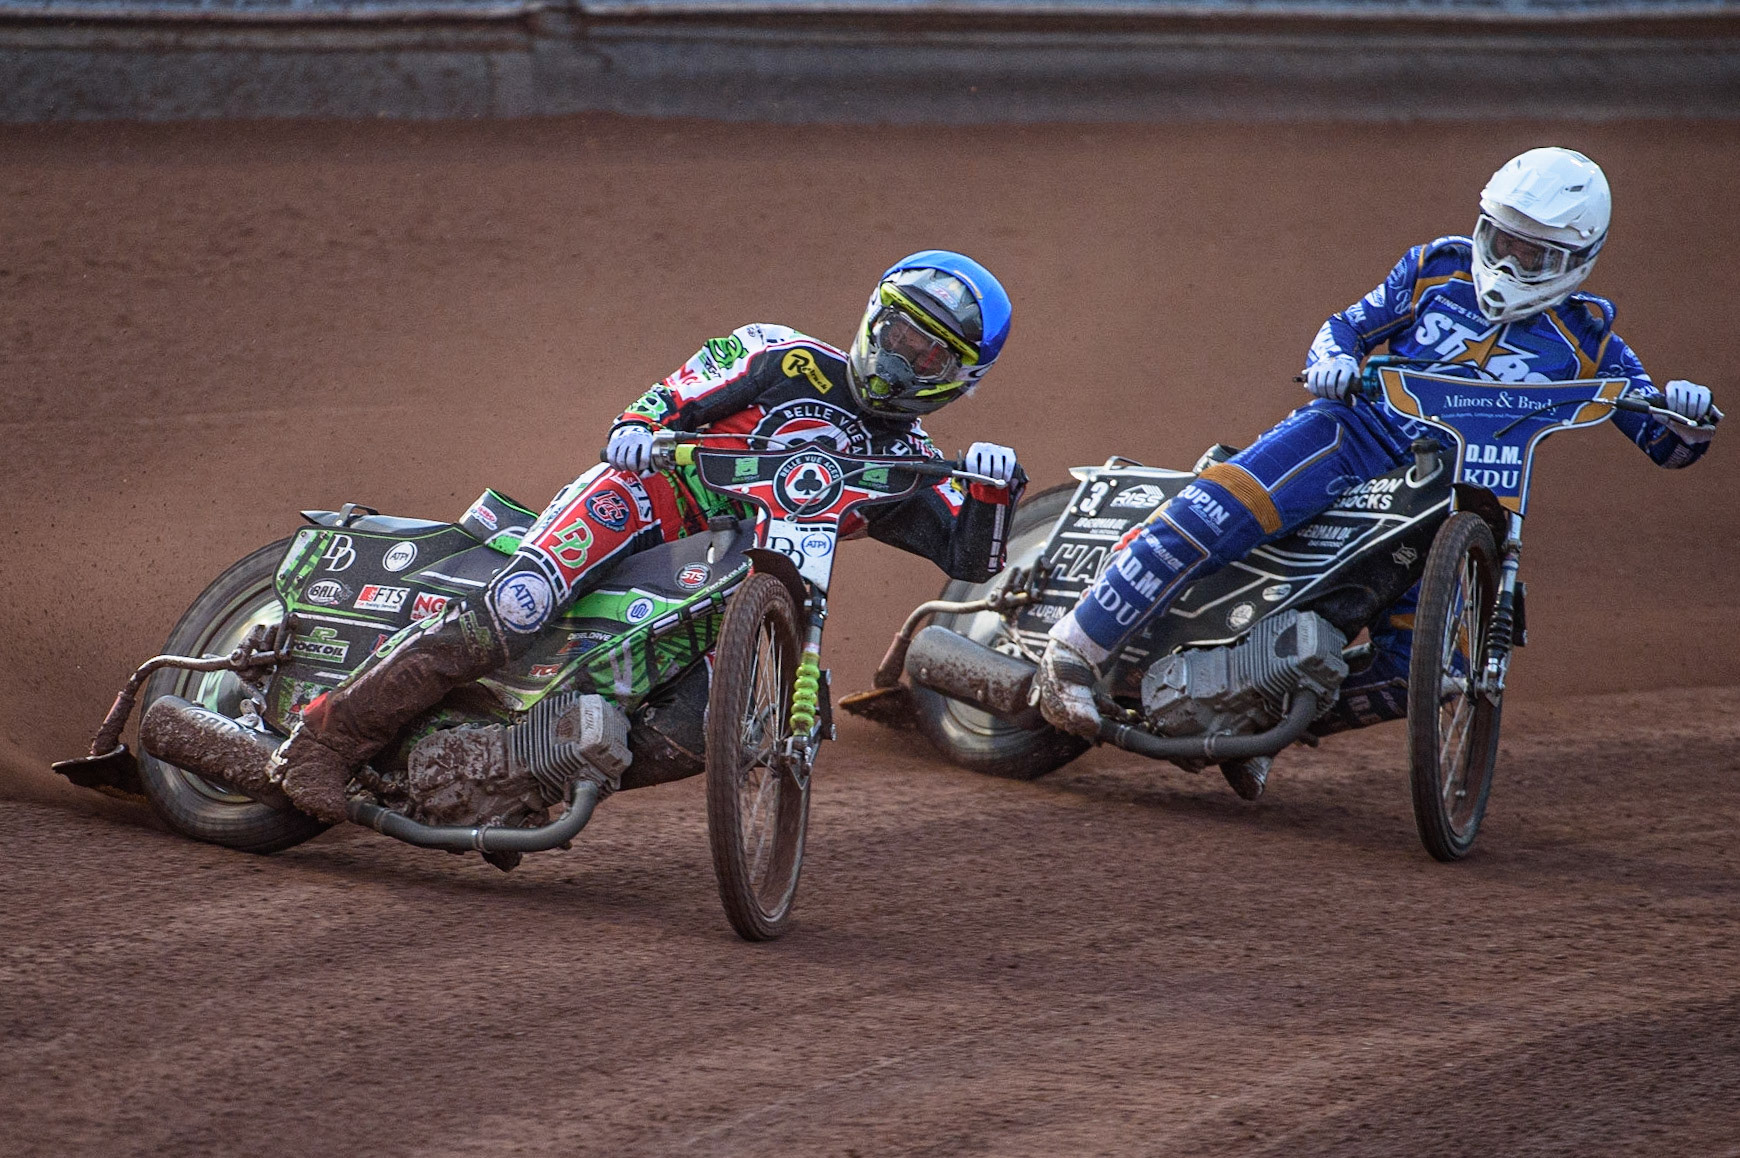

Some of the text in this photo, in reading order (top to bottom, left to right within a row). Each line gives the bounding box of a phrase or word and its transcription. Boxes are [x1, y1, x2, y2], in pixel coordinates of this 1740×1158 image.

[1434, 295, 1467, 316] KING'S
[1443, 394, 1493, 409] Minors
[1496, 391, 1514, 409] &
[784, 404, 865, 444] BELLE VUE
[1465, 444, 1523, 465] D.D.M.
[780, 455, 841, 480] BELLE VUE ACES
[1464, 468, 1520, 489] KDU
[1080, 482, 1109, 512] 3
[805, 538, 828, 549] ATPI
[680, 570, 706, 582] STS
[373, 587, 408, 604] FTS
[510, 582, 537, 619] ATPI
